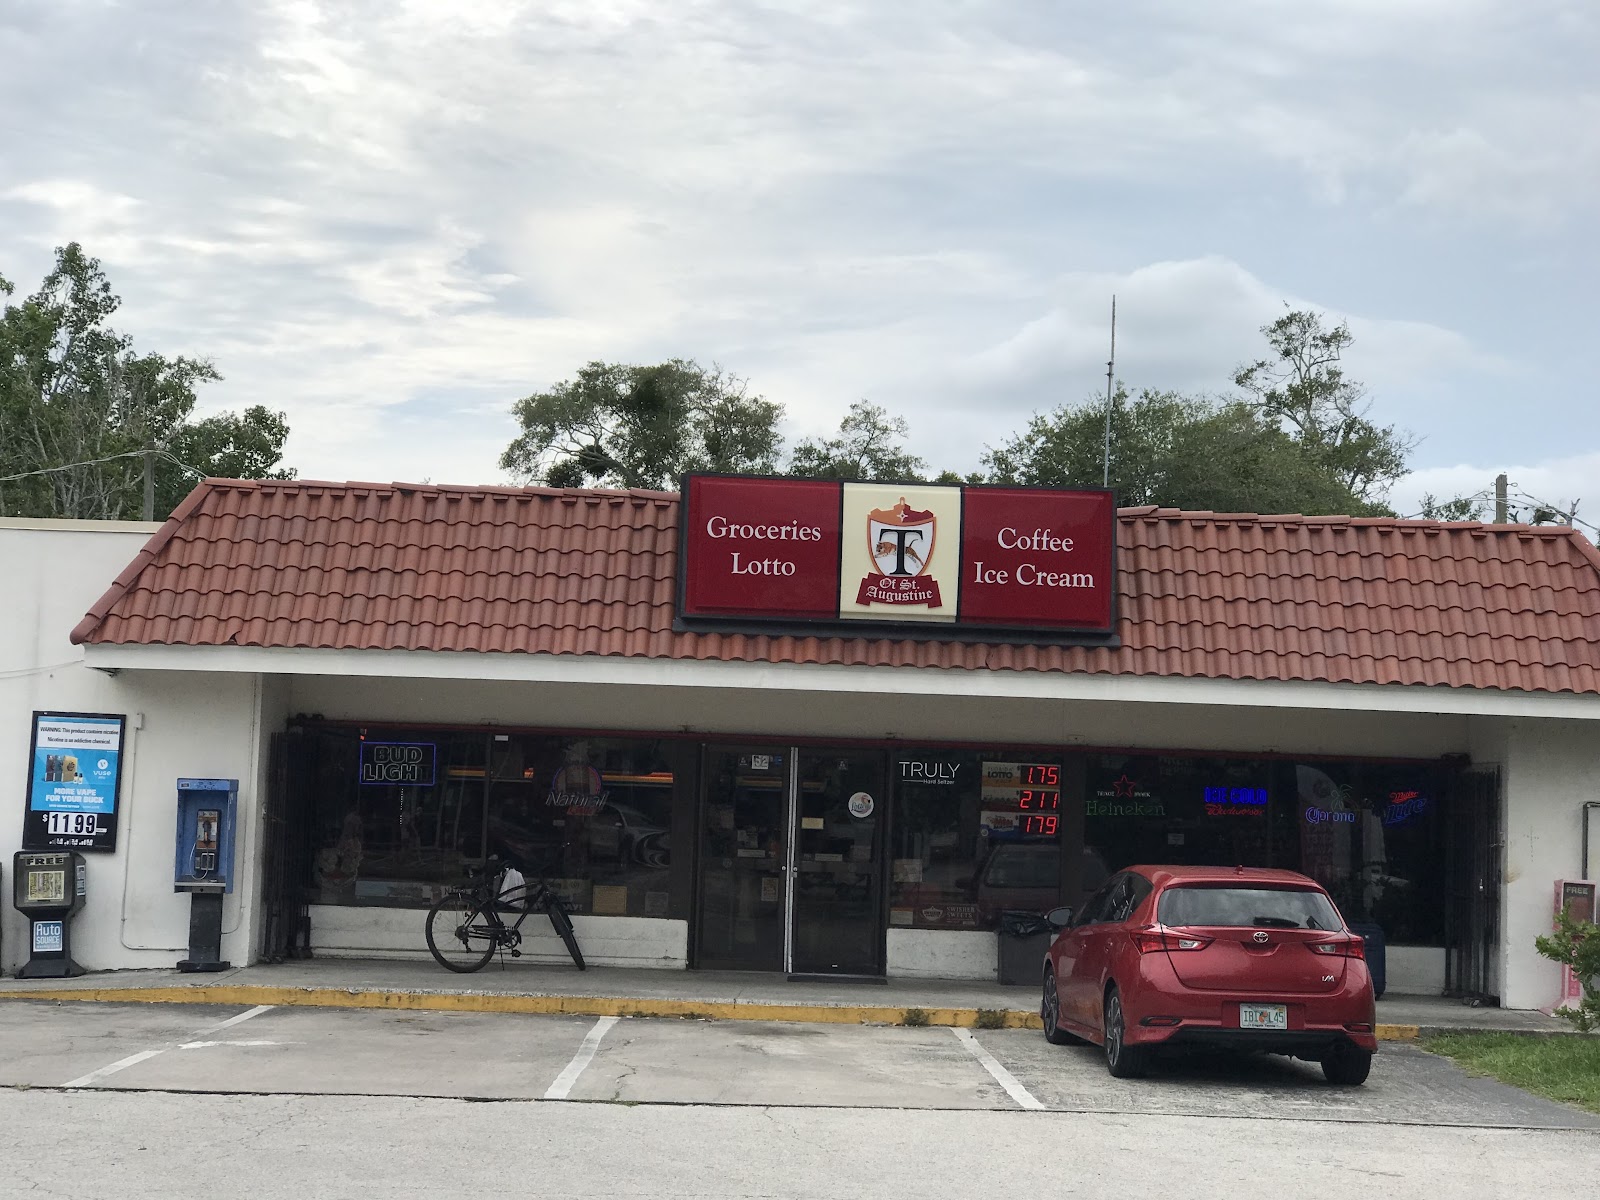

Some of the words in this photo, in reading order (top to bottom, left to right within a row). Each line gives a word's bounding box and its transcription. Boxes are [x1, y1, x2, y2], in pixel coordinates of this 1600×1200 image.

[706, 516, 822, 541] Groceries
[997, 527, 1074, 552] Coffee
[879, 528, 924, 575] T
[730, 552, 796, 576] Lotto
[974, 561, 1009, 585] Ice
[1016, 563, 1096, 588] Cream
[879, 577, 897, 590] Of
[899, 578, 921, 591] St.
[865, 585, 934, 602] Augustine
[373, 746, 423, 763] BUD
[898, 761, 960, 778] TRULY
[988, 771, 1013, 779] LOTTO
[45, 794, 60, 802] FOR
[62, 795, 82, 803] YOUR
[83, 796, 104, 804] BUCK
[53, 787, 75, 796] MORE
[77, 788, 97, 797] VAPE
[1020, 790, 1059, 808] 211
[1204, 786, 1227, 803] ICE
[1230, 787, 1268, 805] COLD
[1085, 800, 1167, 817] Heineken
[1305, 806, 1356, 824] Corona
[1027, 816, 1057, 834] 179
[26, 856, 64, 866] FREE
[1566, 886, 1589, 895] FREE
[36, 923, 60, 936] Auto
[36, 935, 60, 945] SOURCE
